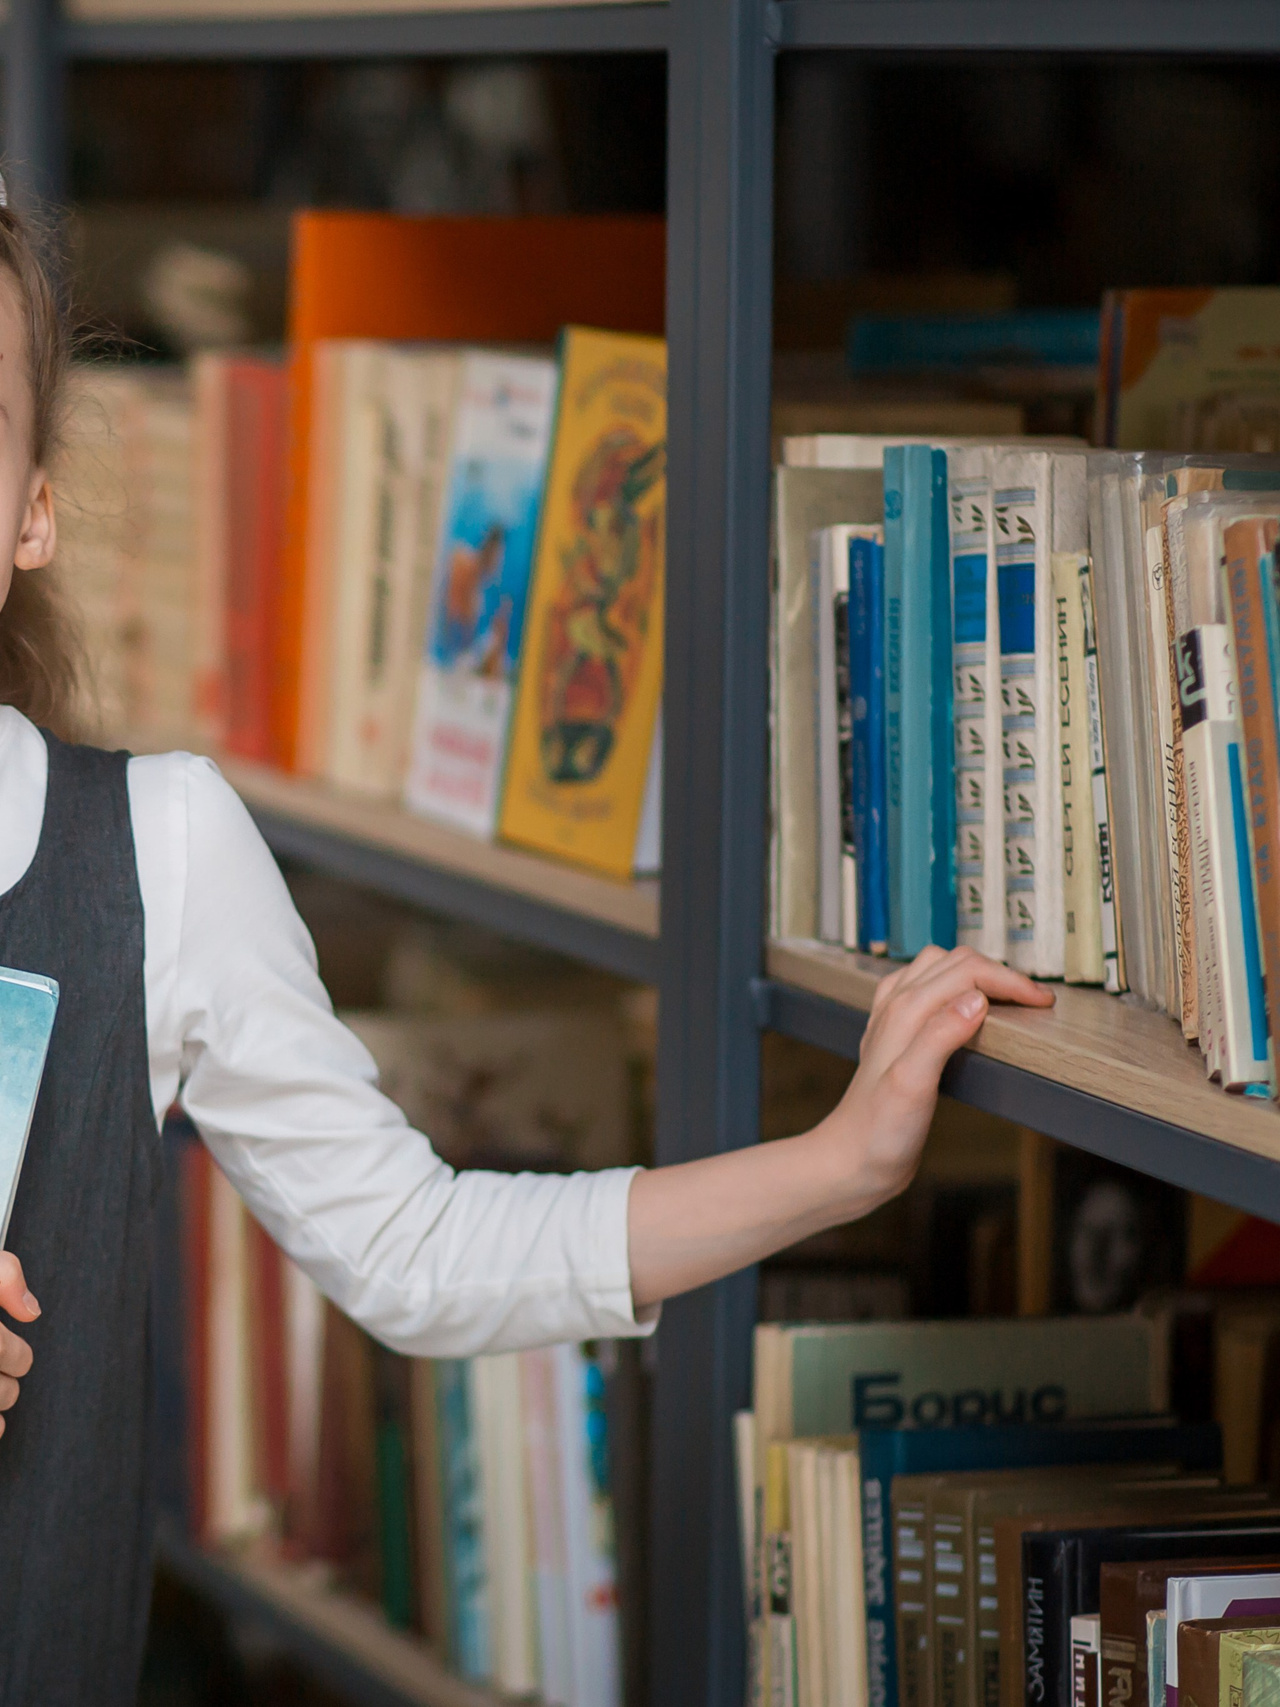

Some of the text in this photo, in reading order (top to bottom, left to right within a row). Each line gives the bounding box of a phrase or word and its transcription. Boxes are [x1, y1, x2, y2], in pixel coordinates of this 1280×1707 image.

[1056, 597, 1070, 727] ЕСЕНИН
[854, 1373, 1068, 1429] Борис
[1027, 1577, 1045, 1702] ЗАМЯТИН
